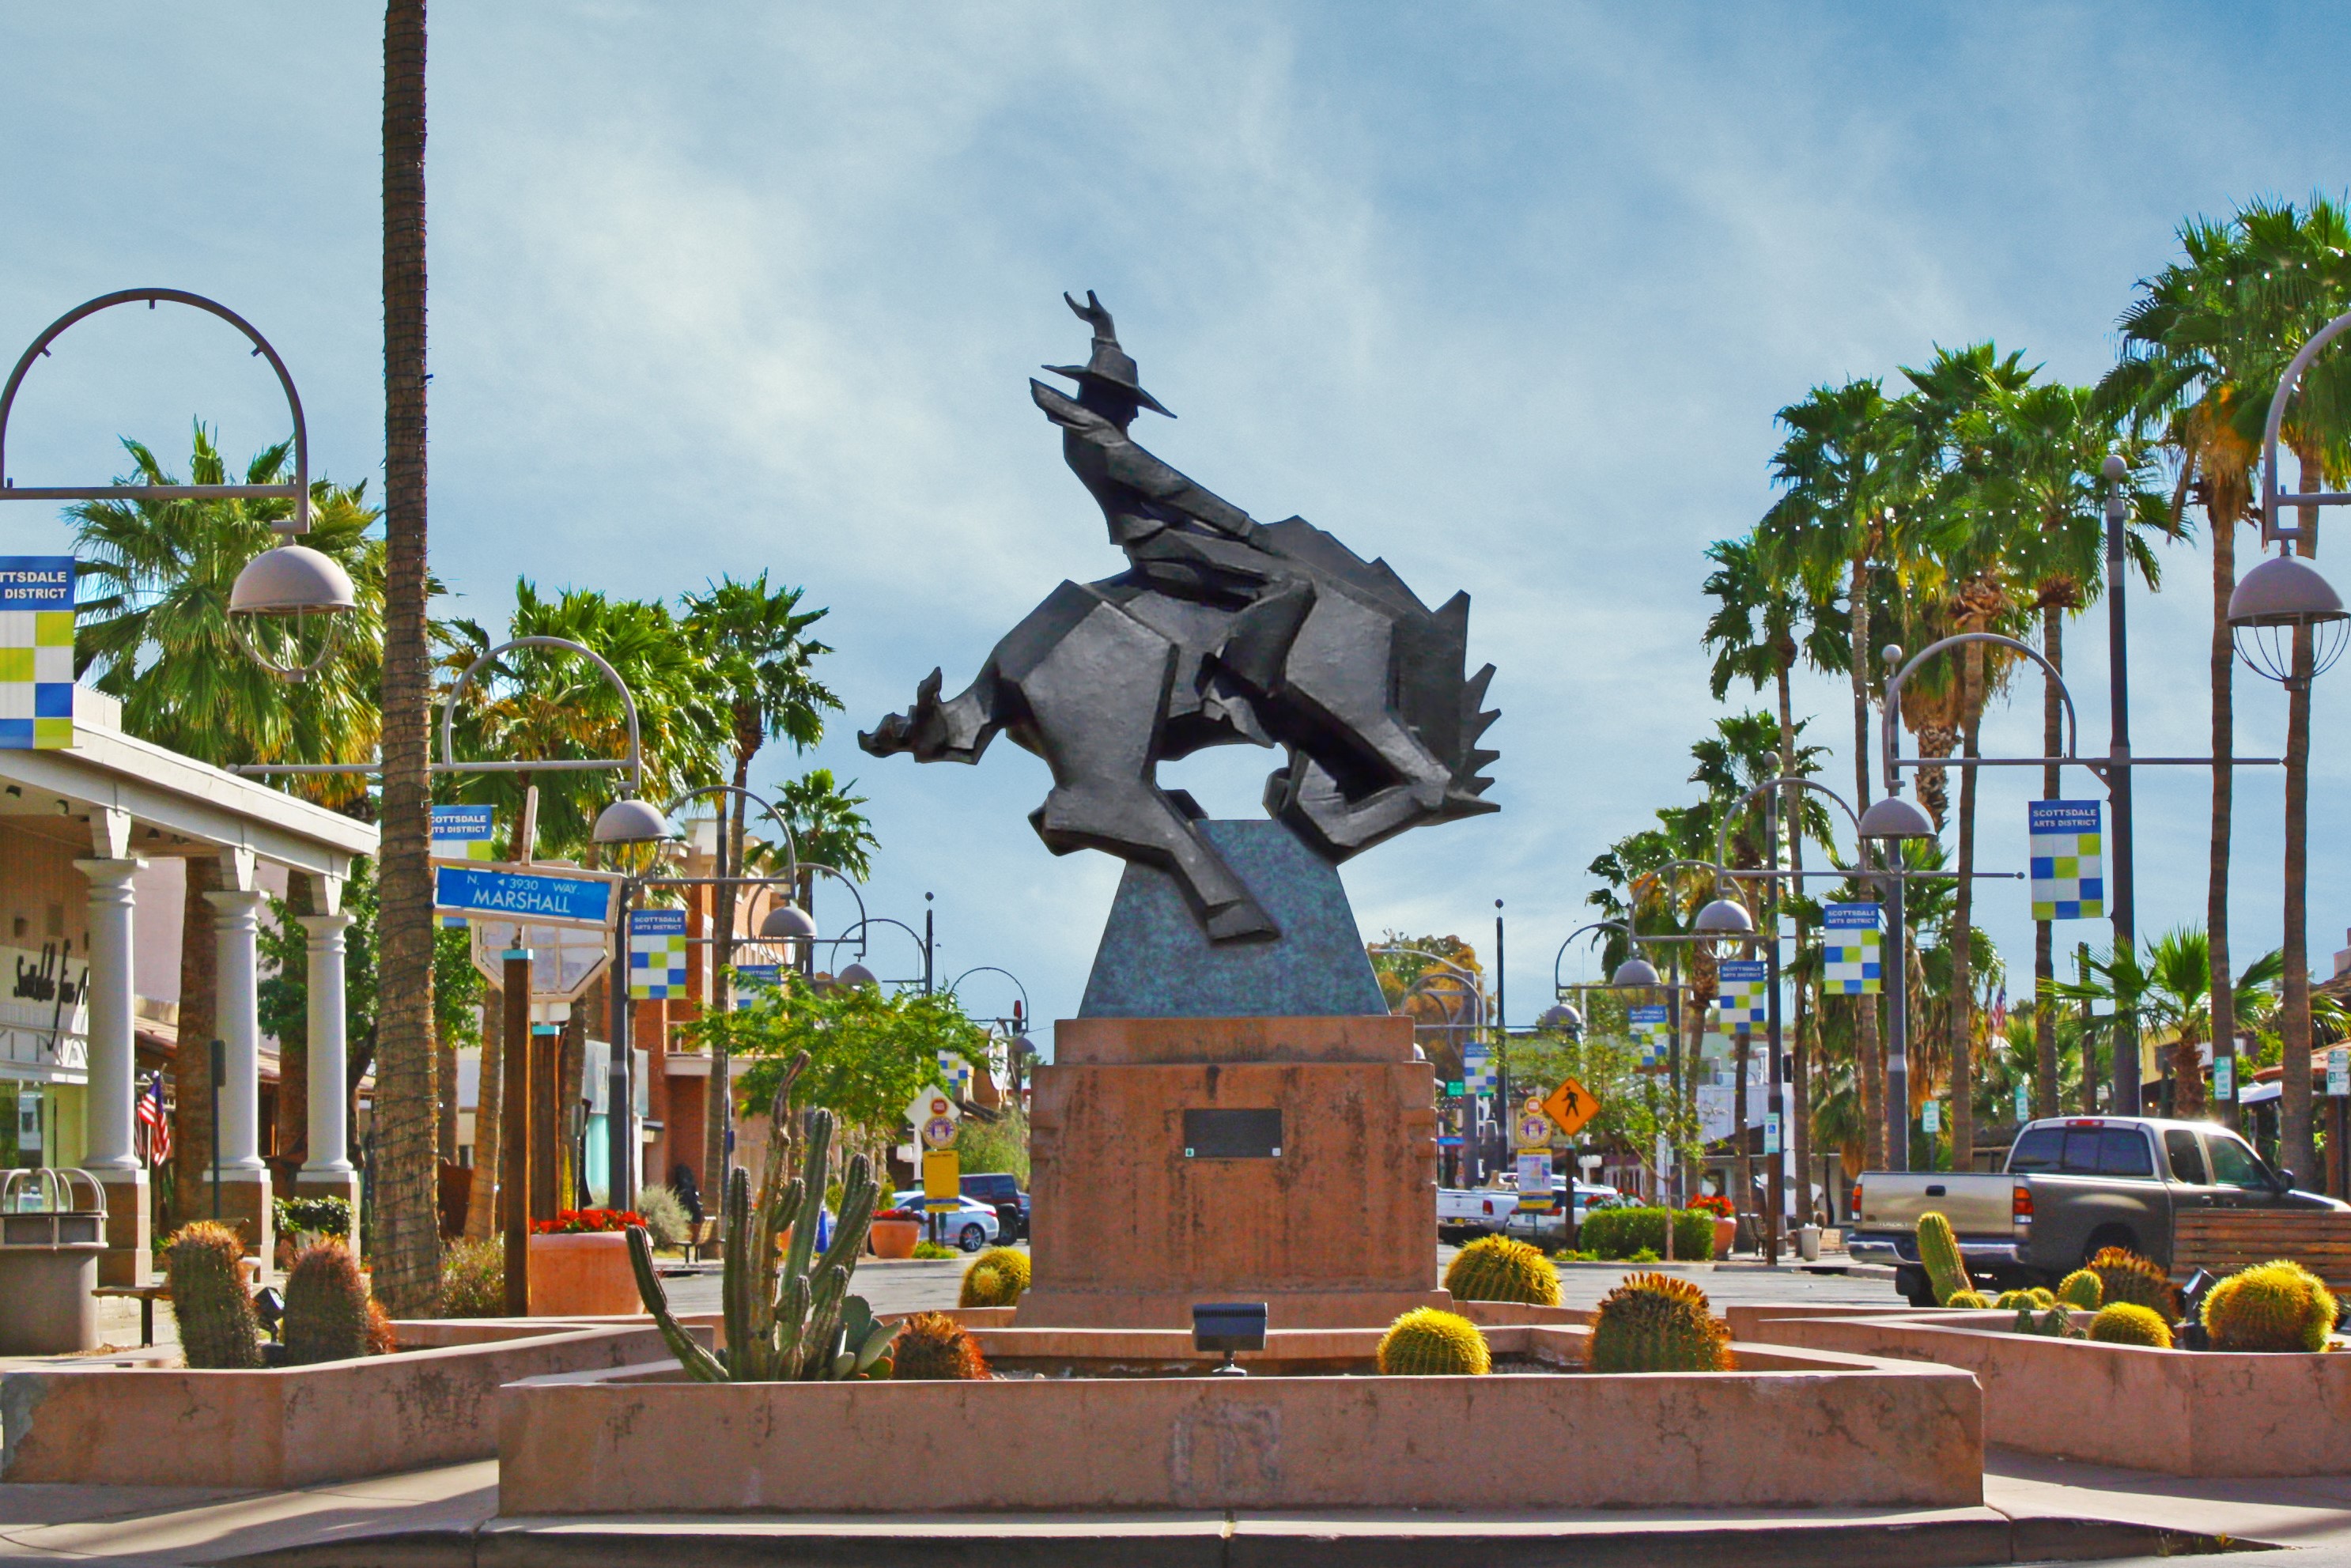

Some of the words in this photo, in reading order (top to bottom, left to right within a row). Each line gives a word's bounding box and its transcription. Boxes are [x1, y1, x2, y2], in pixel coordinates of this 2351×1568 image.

[5, 588, 66, 599] DISTRICT
[467, 874, 480, 886] N.
[509, 878, 539, 890] 3930
[472, 887, 571, 913] MARSHALL
